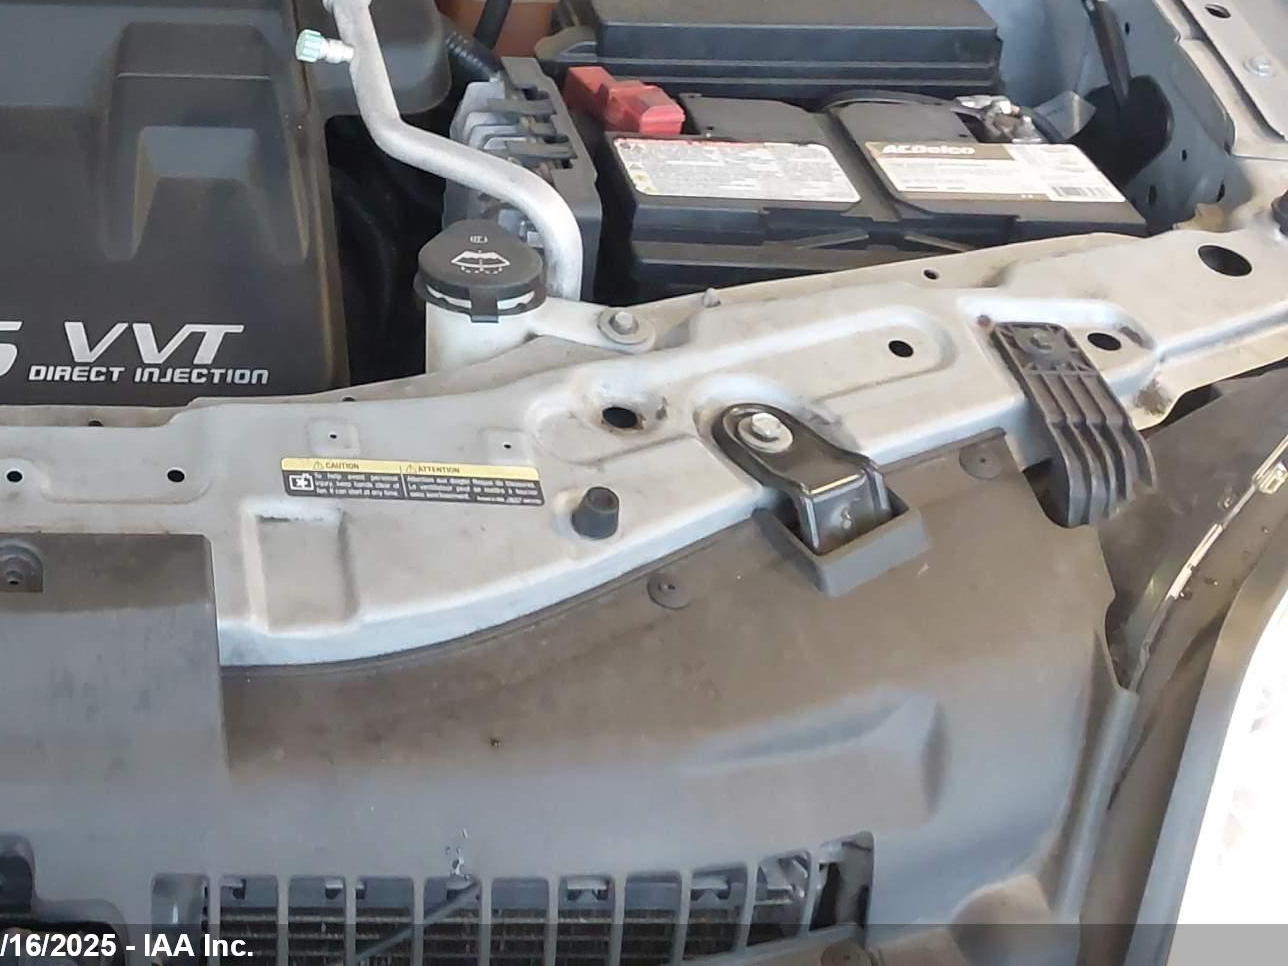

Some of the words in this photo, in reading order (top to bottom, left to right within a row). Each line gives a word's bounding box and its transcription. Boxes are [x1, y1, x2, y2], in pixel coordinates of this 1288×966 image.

[64, 321, 245, 365] VVT
[28, 365, 125, 382] DIRECT
[325, 461, 360, 470] CAUTION
[418, 465, 460, 474] ATTENTION
